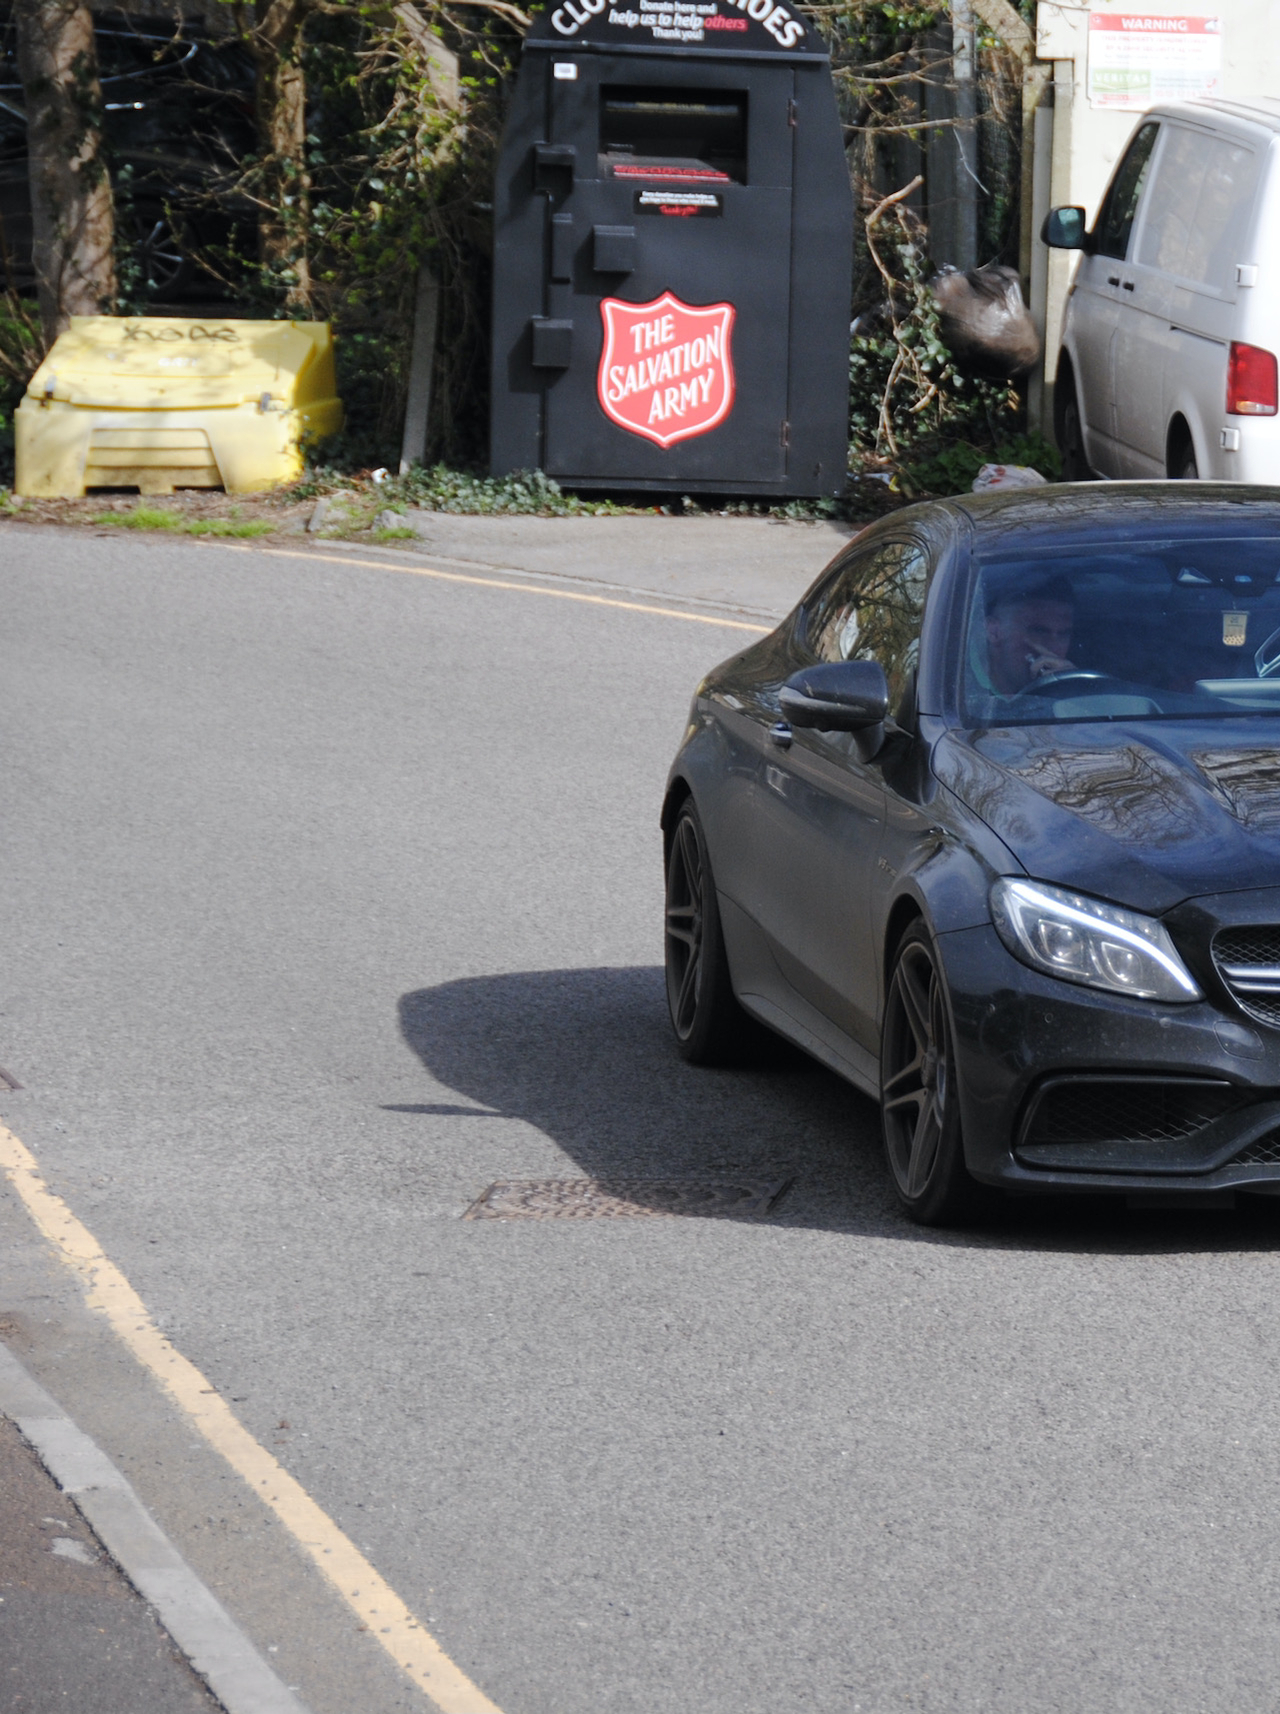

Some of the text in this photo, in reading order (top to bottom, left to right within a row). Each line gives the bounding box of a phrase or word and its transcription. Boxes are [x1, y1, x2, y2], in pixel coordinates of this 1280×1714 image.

[640, 0, 717, 15] Donate here and
[608, 9, 748, 32] help us to help others
[1121, 17, 1188, 31] WARNING
[652, 26, 705, 42] Thank you!
[1095, 73, 1148, 83] VERITAS
[630, 313, 675, 354] THE
[608, 325, 720, 403] SALVATION
[648, 368, 715, 425] ARMY
